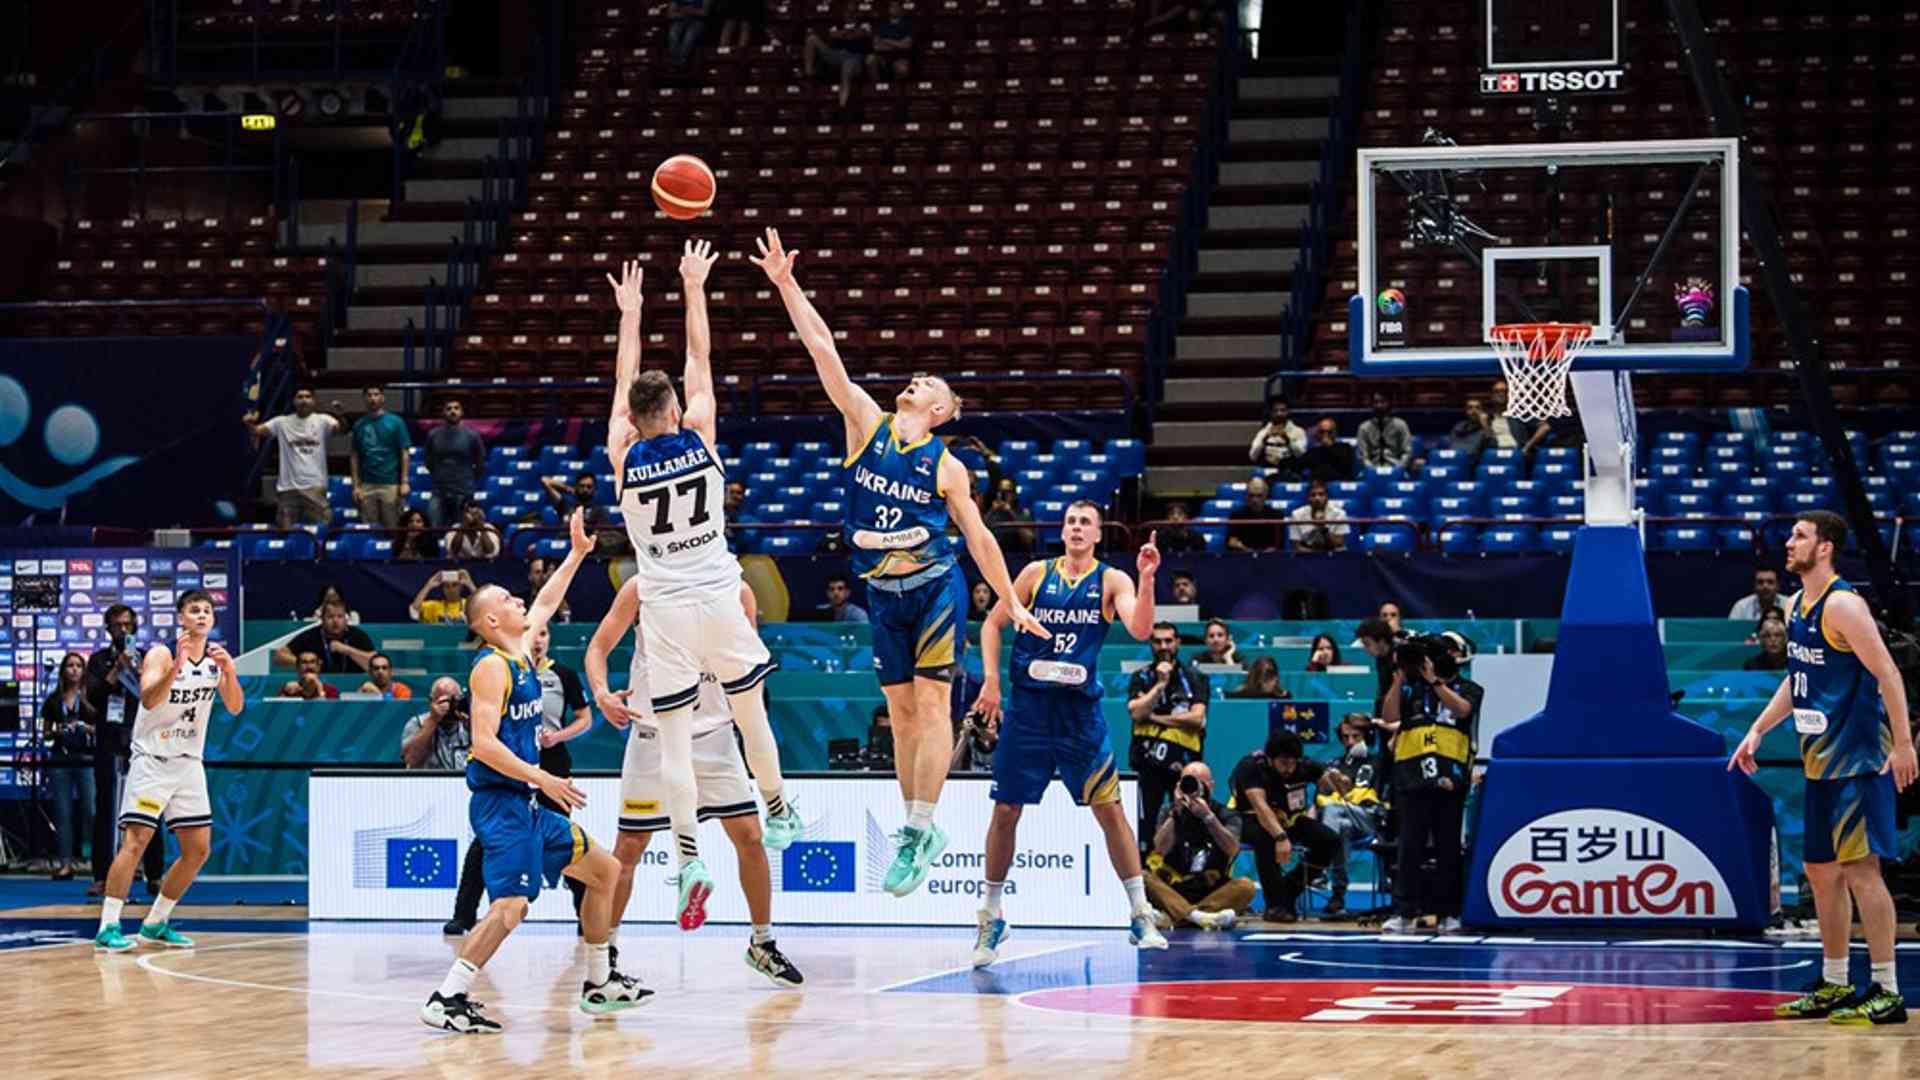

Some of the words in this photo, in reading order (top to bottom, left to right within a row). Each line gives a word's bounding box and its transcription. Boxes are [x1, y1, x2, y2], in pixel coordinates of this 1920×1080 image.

[1520, 70, 1624, 91] TISSOT
[1380, 321, 1402, 334] FIBA
[627, 448, 708, 482] KULLAMÄE
[855, 464, 931, 504] UKRAINE
[637, 474, 710, 535] 77
[875, 504, 902, 529] 32
[1034, 607, 1100, 624] UKRAINE
[1053, 632, 1077, 654] 52
[1793, 671, 1807, 698] 10
[1529, 827, 1666, 863] 百岁山
[928, 879, 1017, 898] europa
